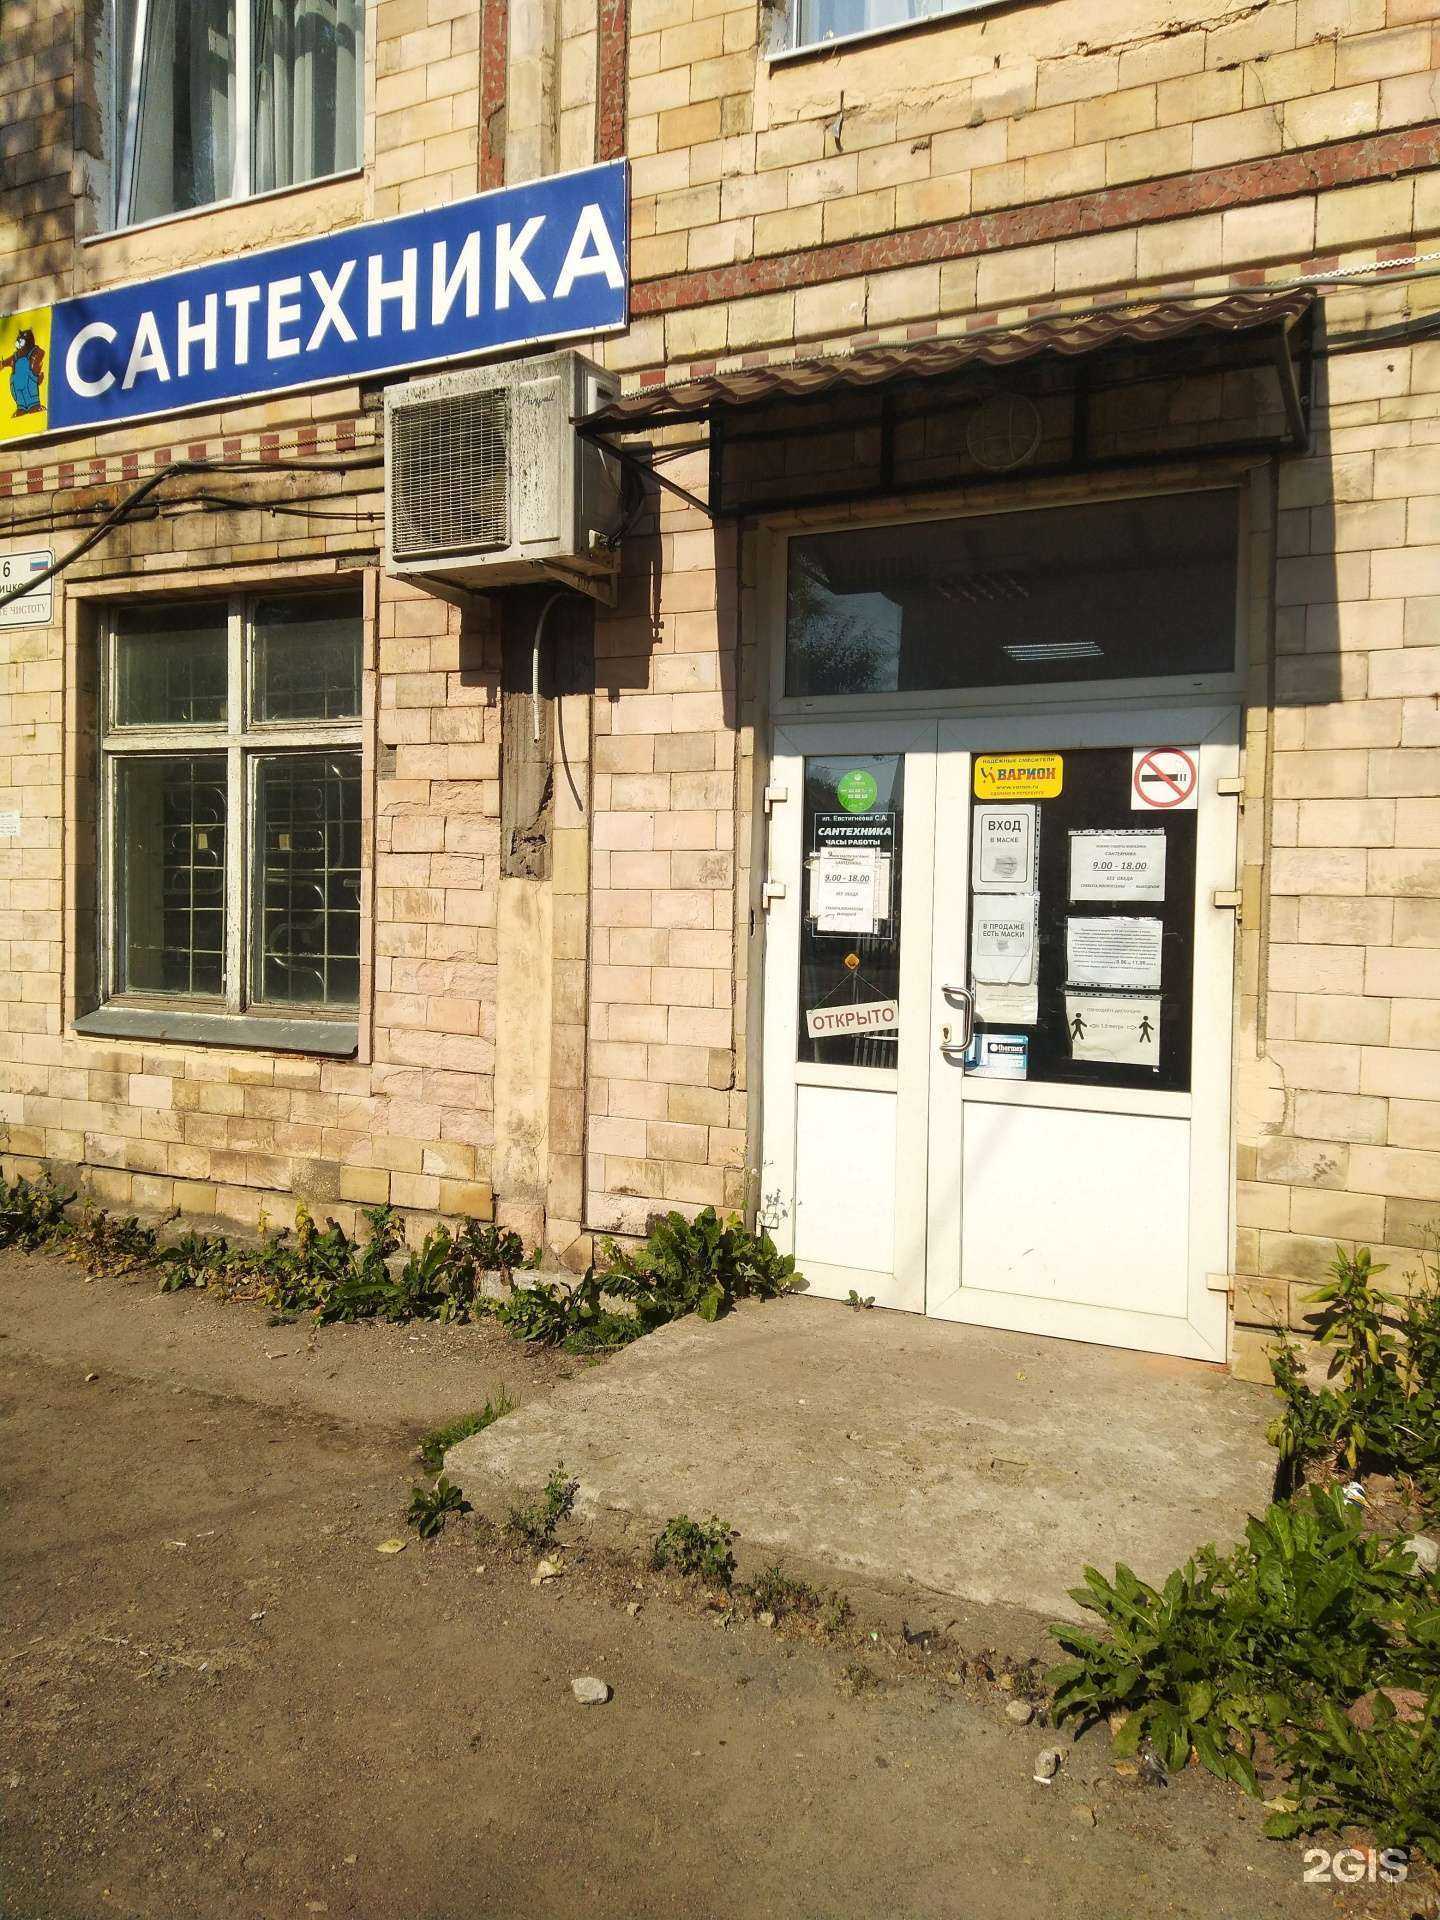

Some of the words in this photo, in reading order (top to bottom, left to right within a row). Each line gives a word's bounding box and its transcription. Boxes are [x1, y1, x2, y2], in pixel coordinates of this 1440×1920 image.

[65, 203, 626, 398] САНТЕХНИКА
[3, 561, 11, 577] 6
[997, 767, 1057, 781] ВАРИОН
[818, 827, 892, 836] САНТЕХНИКА
[988, 820, 1021, 832] ВХОД
[1092, 861, 1113, 870] 9.00
[824, 874, 842, 882] 9.00
[812, 1007, 895, 1030] ОТКРЫТО
